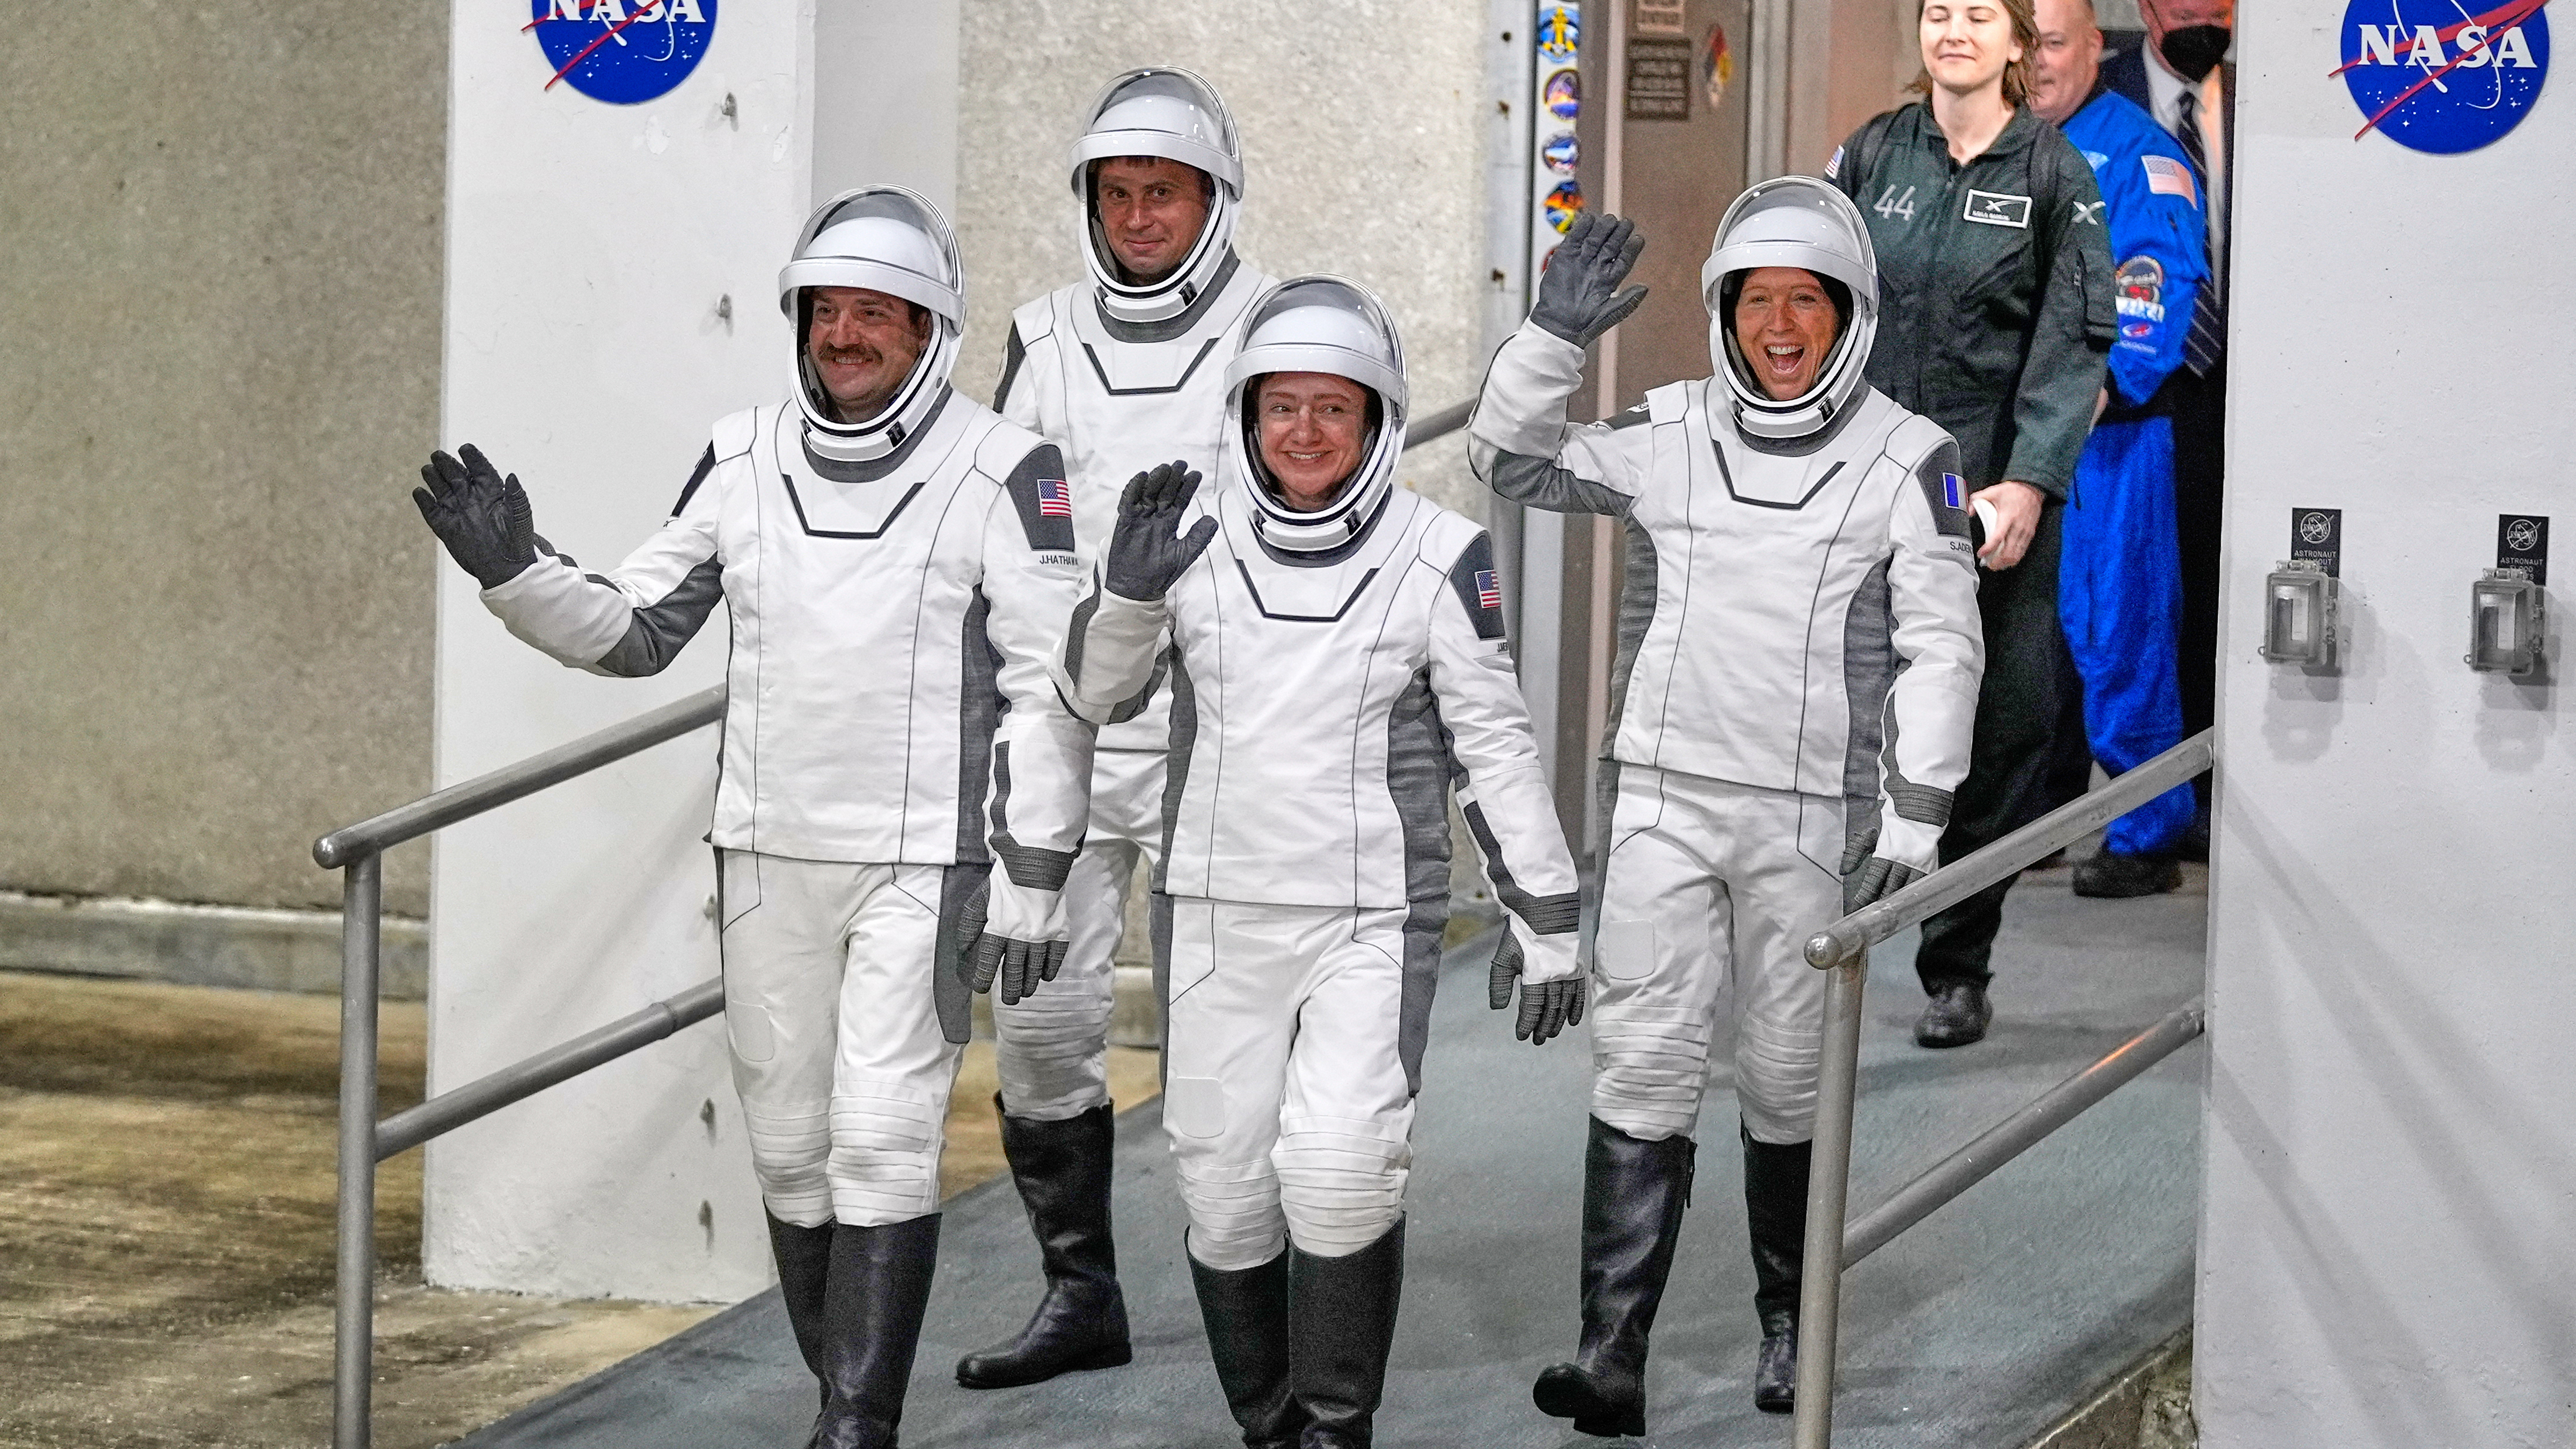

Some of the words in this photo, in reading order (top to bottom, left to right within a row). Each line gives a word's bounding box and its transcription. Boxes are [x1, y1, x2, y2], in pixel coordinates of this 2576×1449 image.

[2358, 24, 2537, 68] NASA
[1873, 185, 1915, 221] 44
[2294, 550, 2337, 559] ASTRONAUT
[2500, 557, 2543, 566] ASTRONAUT
